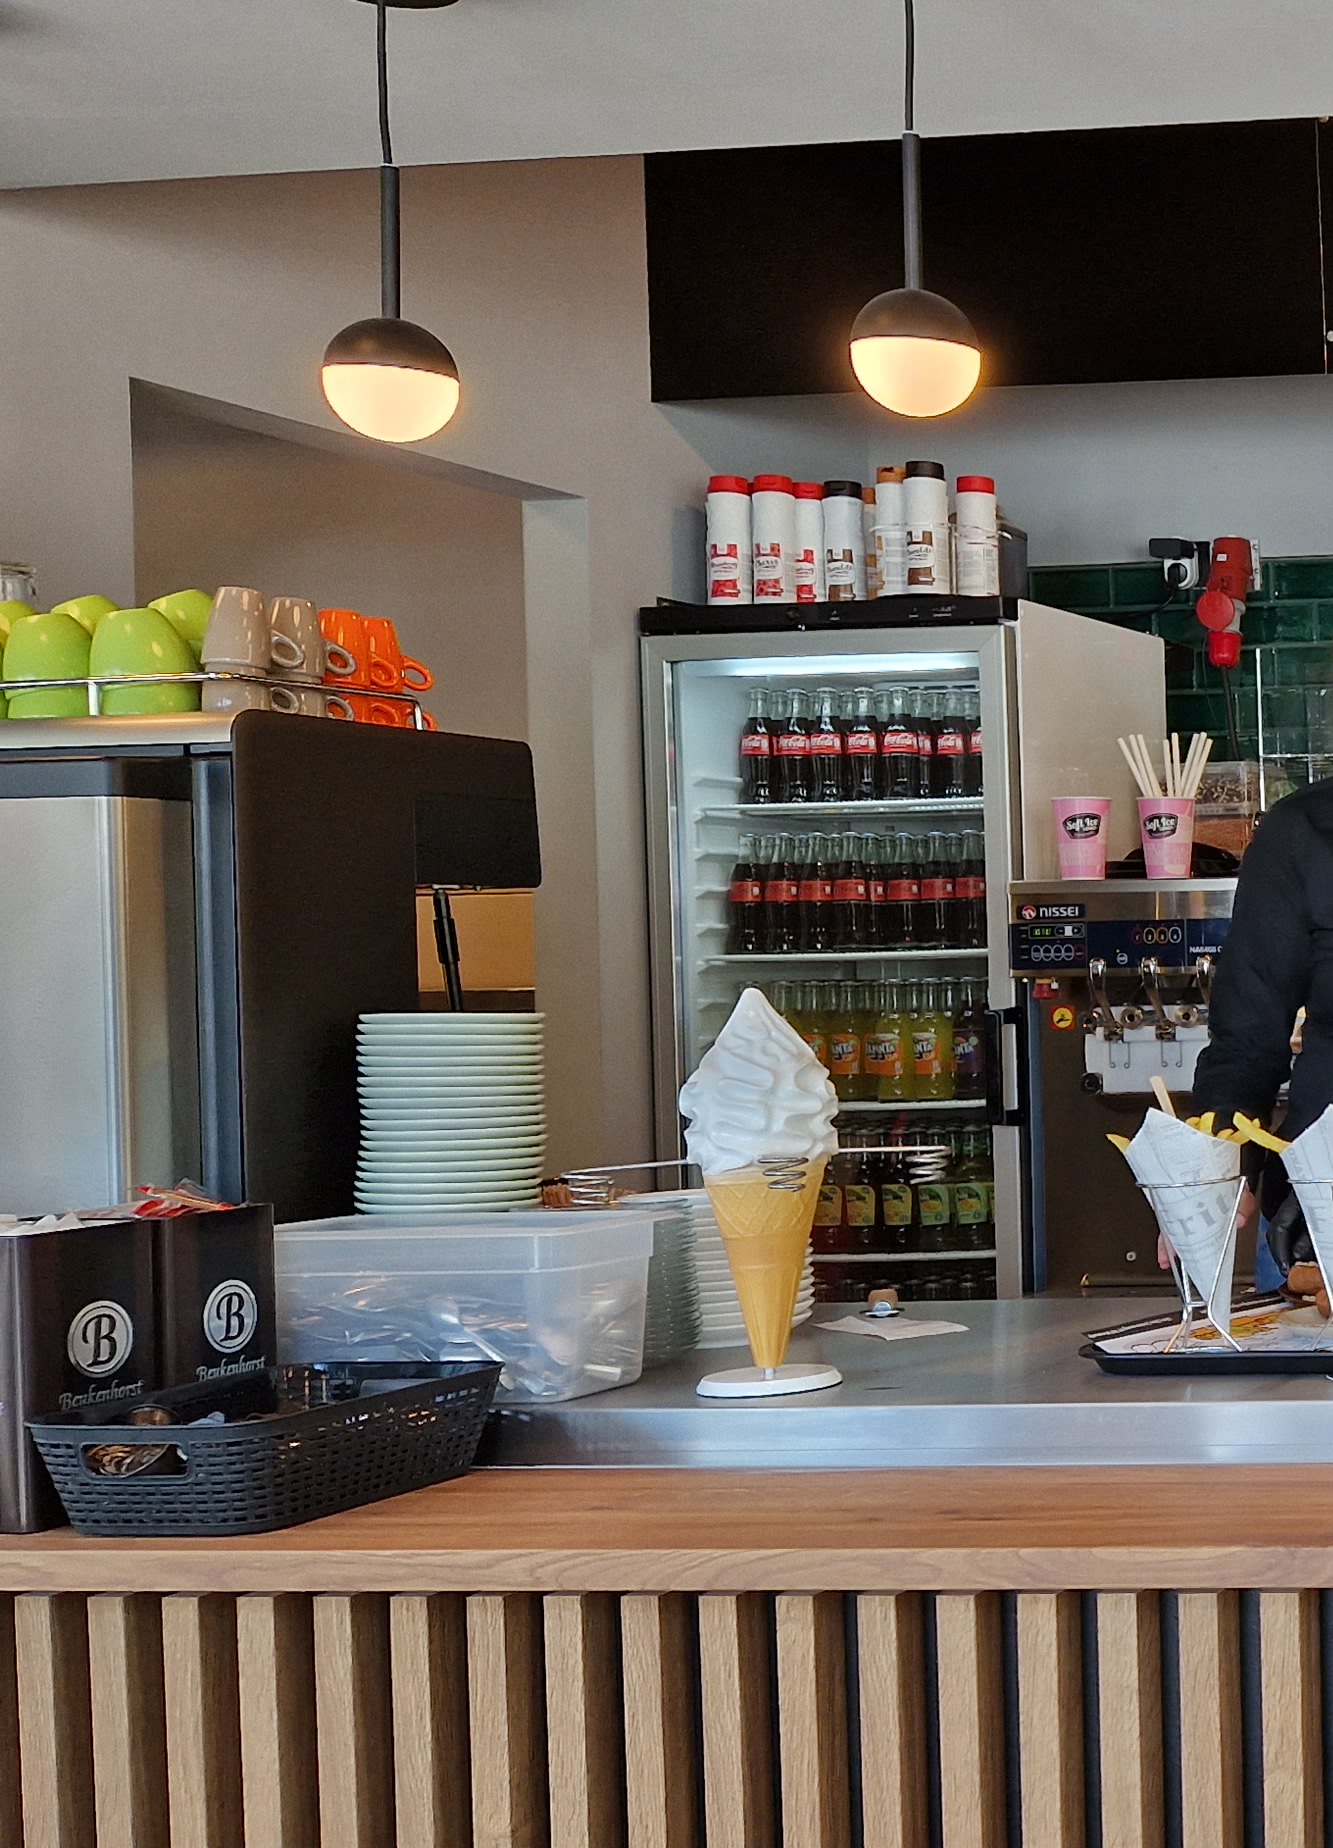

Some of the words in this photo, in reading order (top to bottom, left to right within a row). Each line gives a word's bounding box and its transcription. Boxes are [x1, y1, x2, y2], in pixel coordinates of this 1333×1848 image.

[1039, 906, 1079, 917] NISSEI
[82, 1313, 117, 1368] B
[216, 1292, 245, 1343] B
